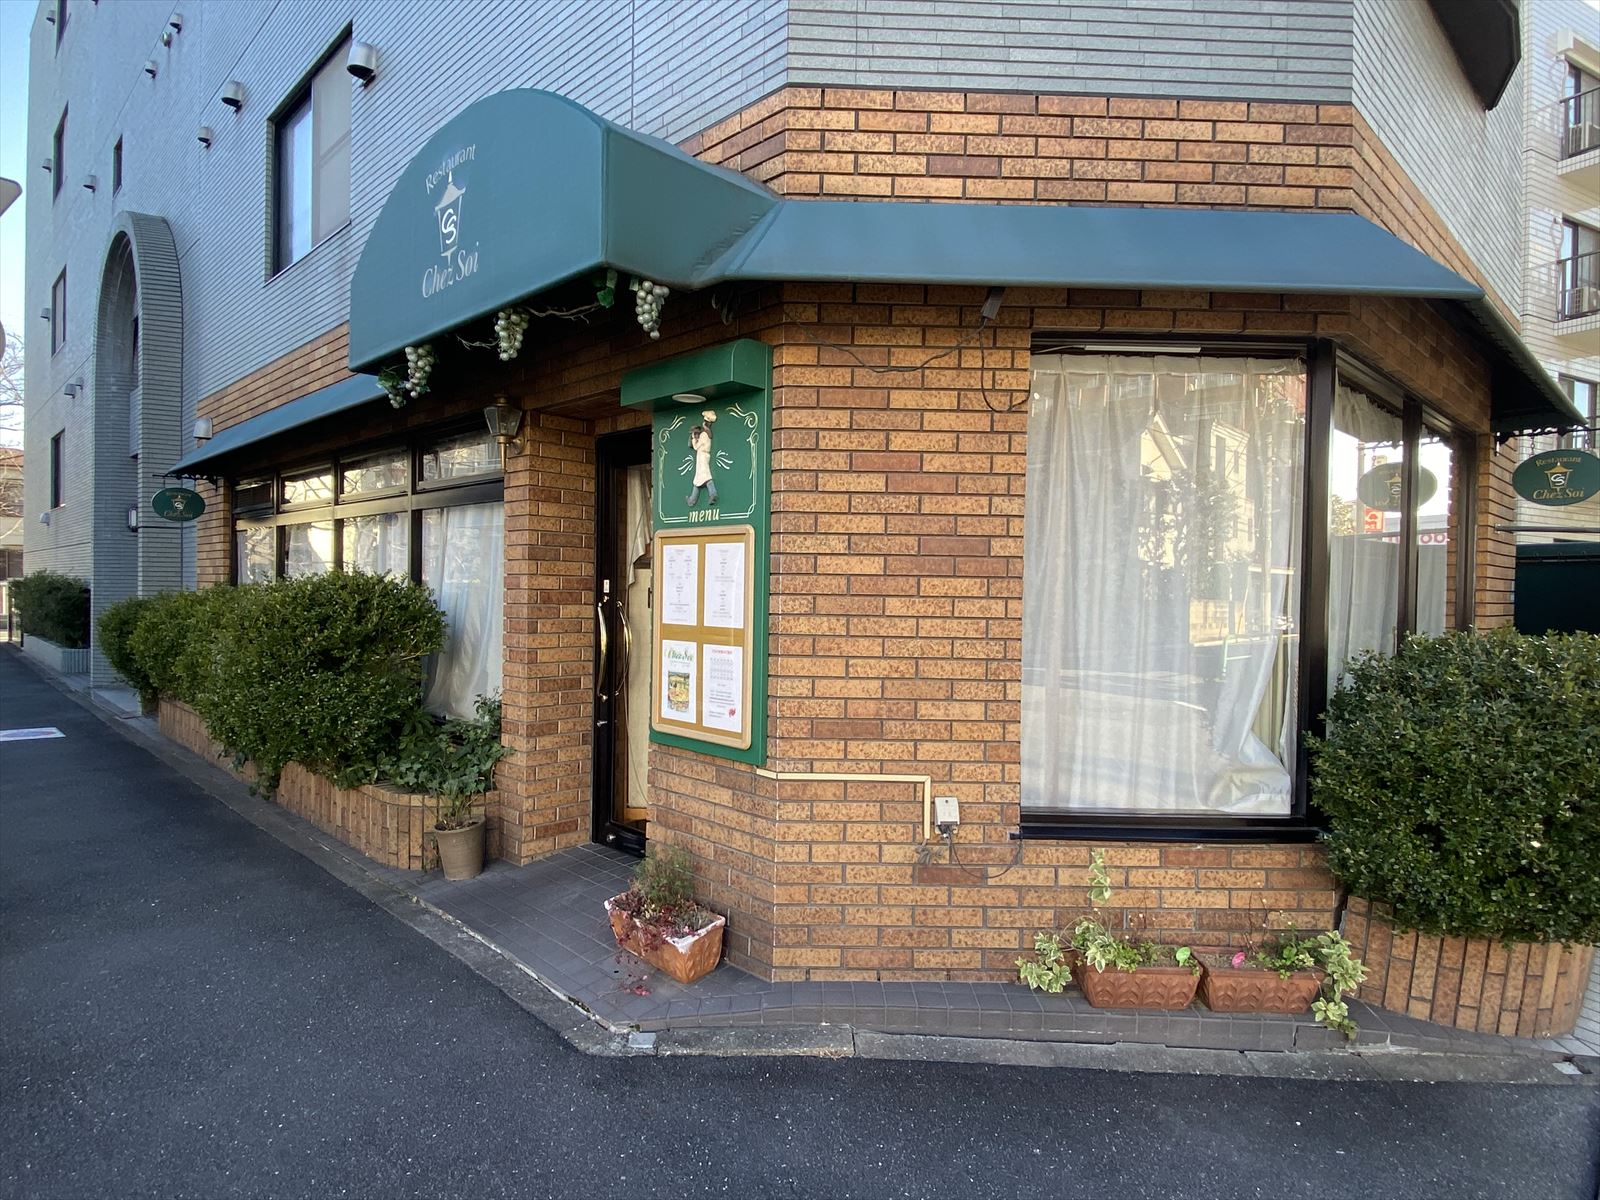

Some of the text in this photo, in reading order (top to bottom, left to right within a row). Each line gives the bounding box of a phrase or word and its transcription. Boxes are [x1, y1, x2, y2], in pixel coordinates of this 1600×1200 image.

[425, 143, 476, 195] Restaurant
[422, 241, 479, 298] Chez Soi
[1565, 487, 1585, 498] Soi
[688, 508, 720, 523] menu
